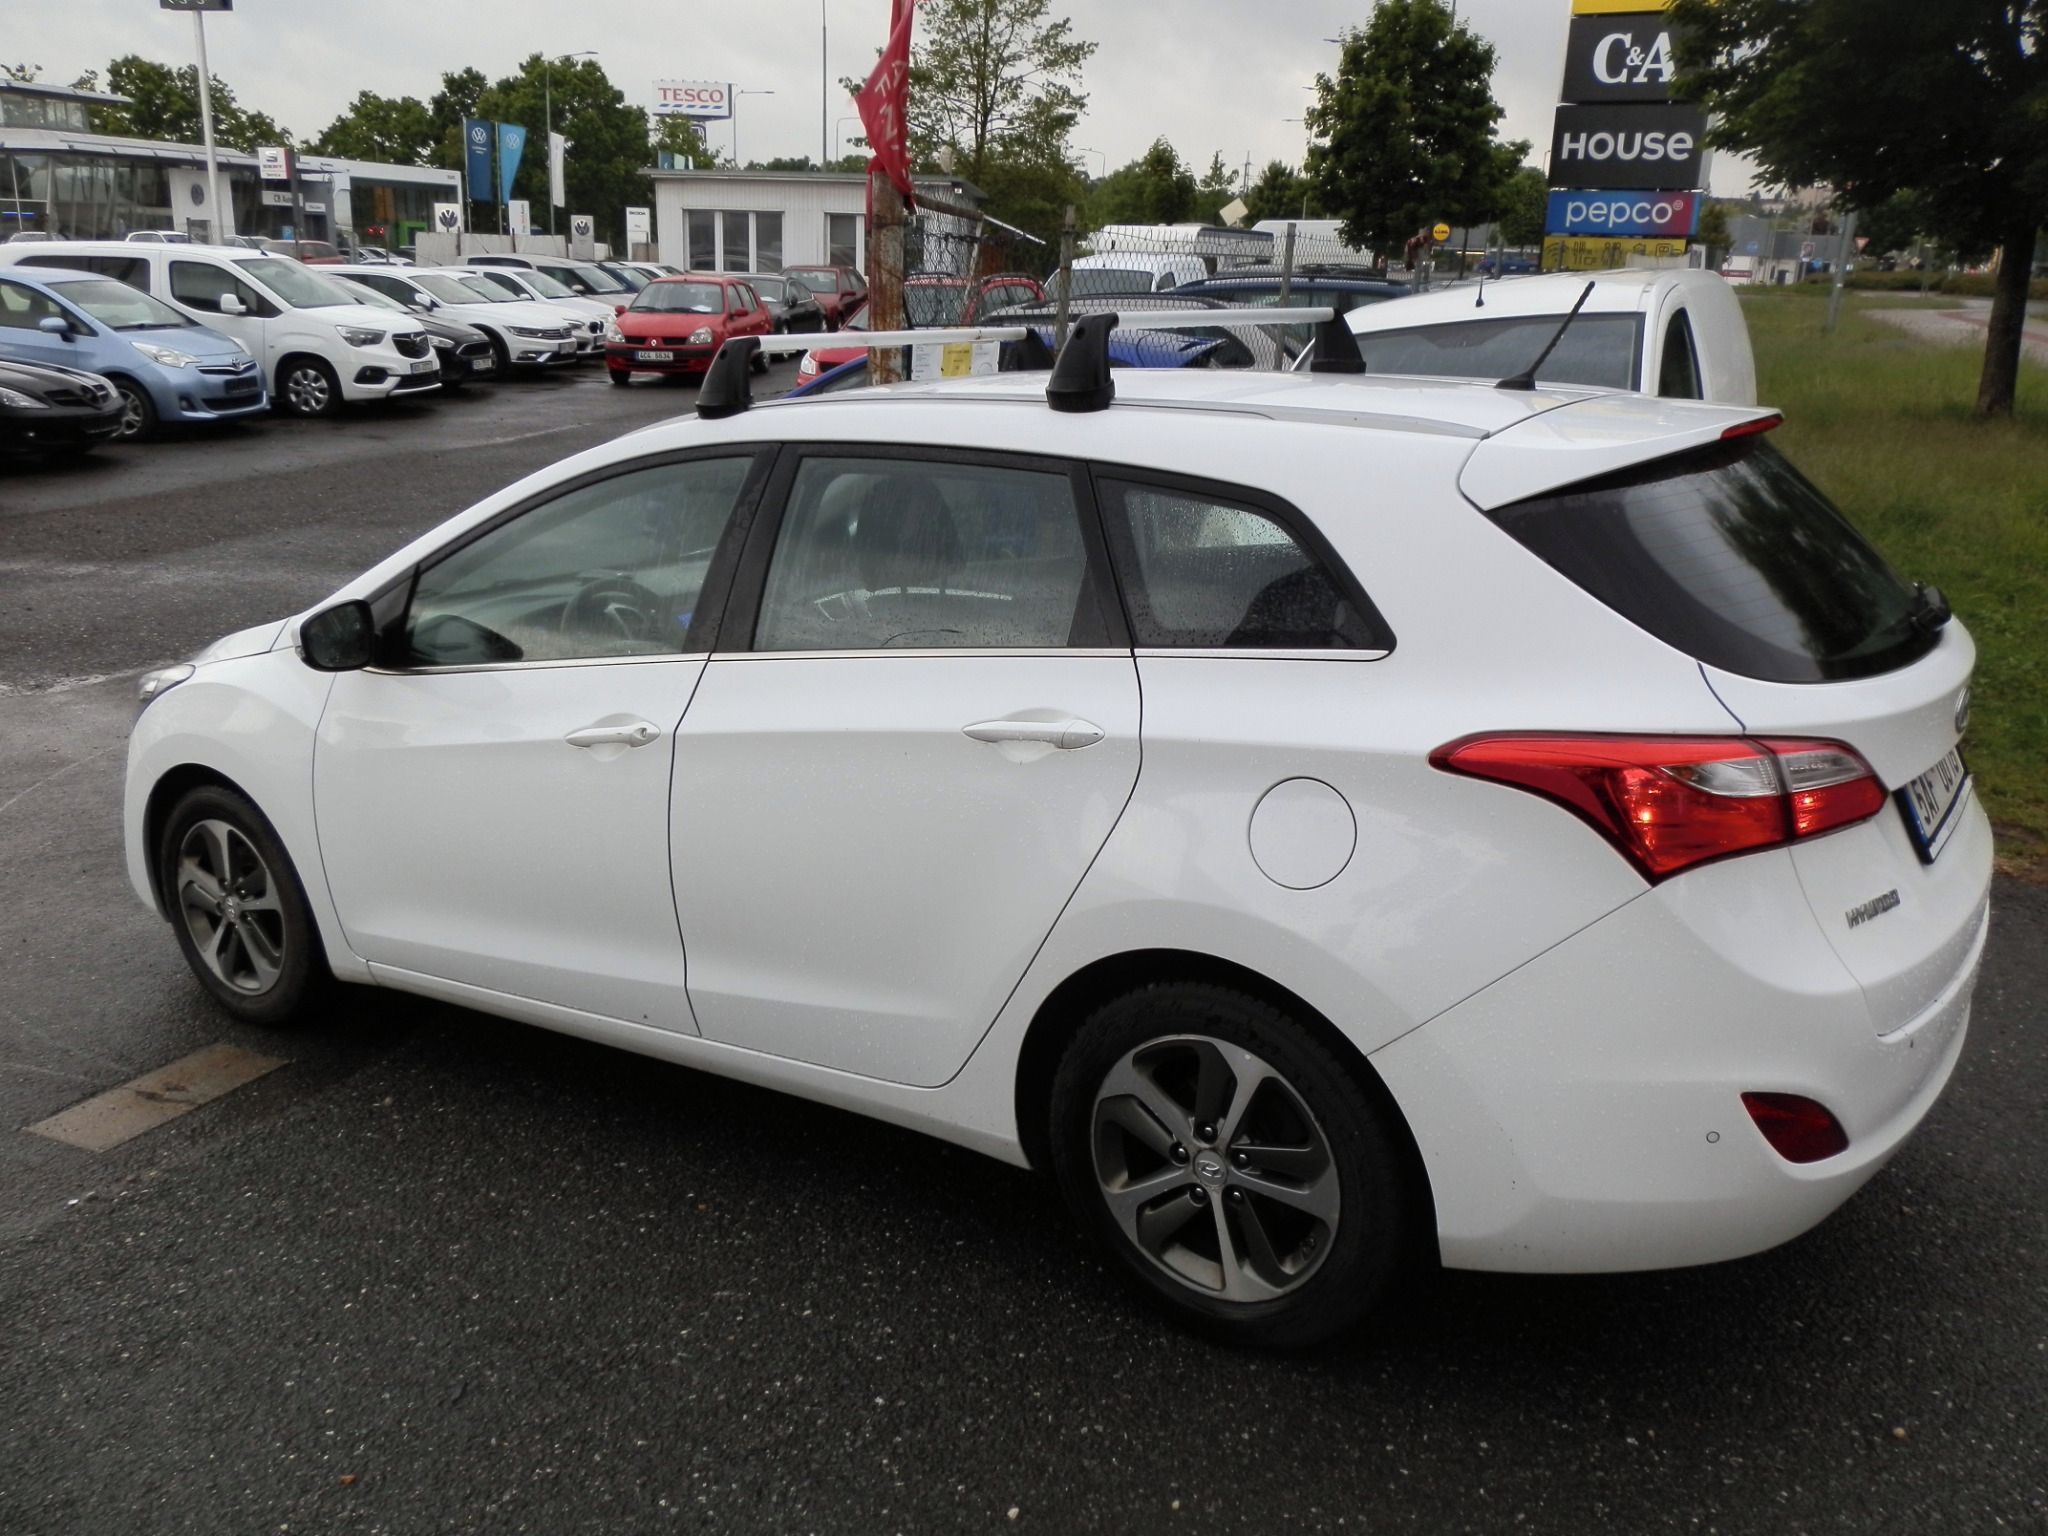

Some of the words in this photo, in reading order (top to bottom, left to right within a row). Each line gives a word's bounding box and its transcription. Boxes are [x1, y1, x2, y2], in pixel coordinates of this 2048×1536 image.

[1593, 32, 1676, 84] C&A
[658, 87, 724, 103] TESCO
[1565, 201, 1673, 229] pepco
